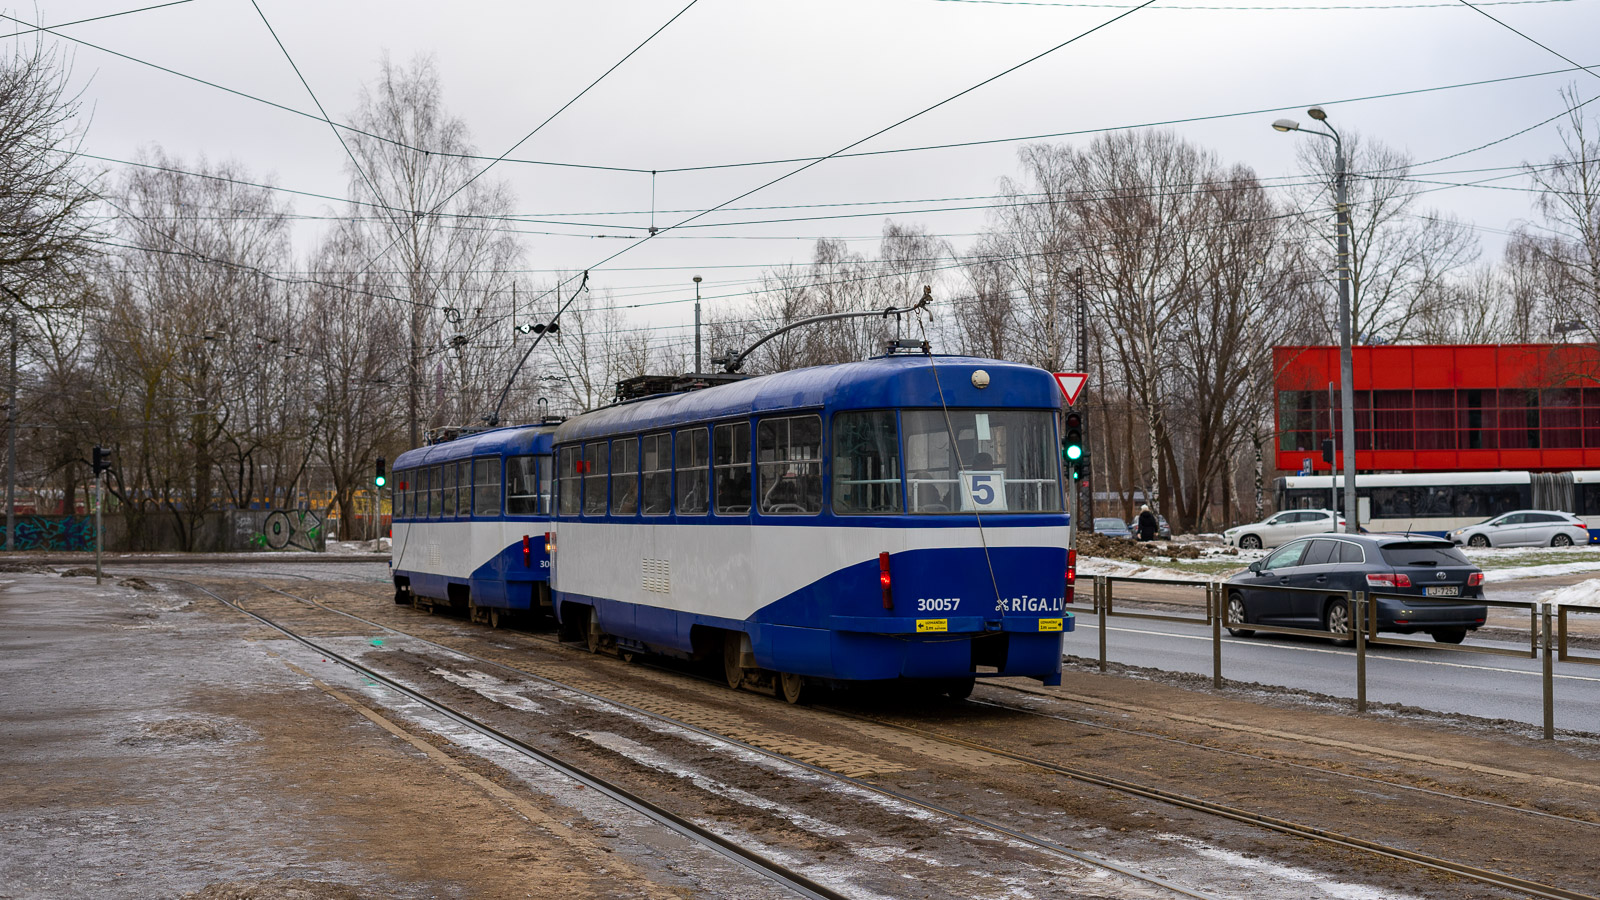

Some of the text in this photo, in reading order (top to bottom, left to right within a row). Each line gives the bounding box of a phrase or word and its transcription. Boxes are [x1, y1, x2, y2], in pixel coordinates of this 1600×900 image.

[972, 476, 995, 505] 5
[540, 560, 551, 568] 30
[1427, 587, 1458, 595] LJ-7252
[917, 598, 961, 611] 30057
[1012, 595, 1065, 611] RĪGA.LV
